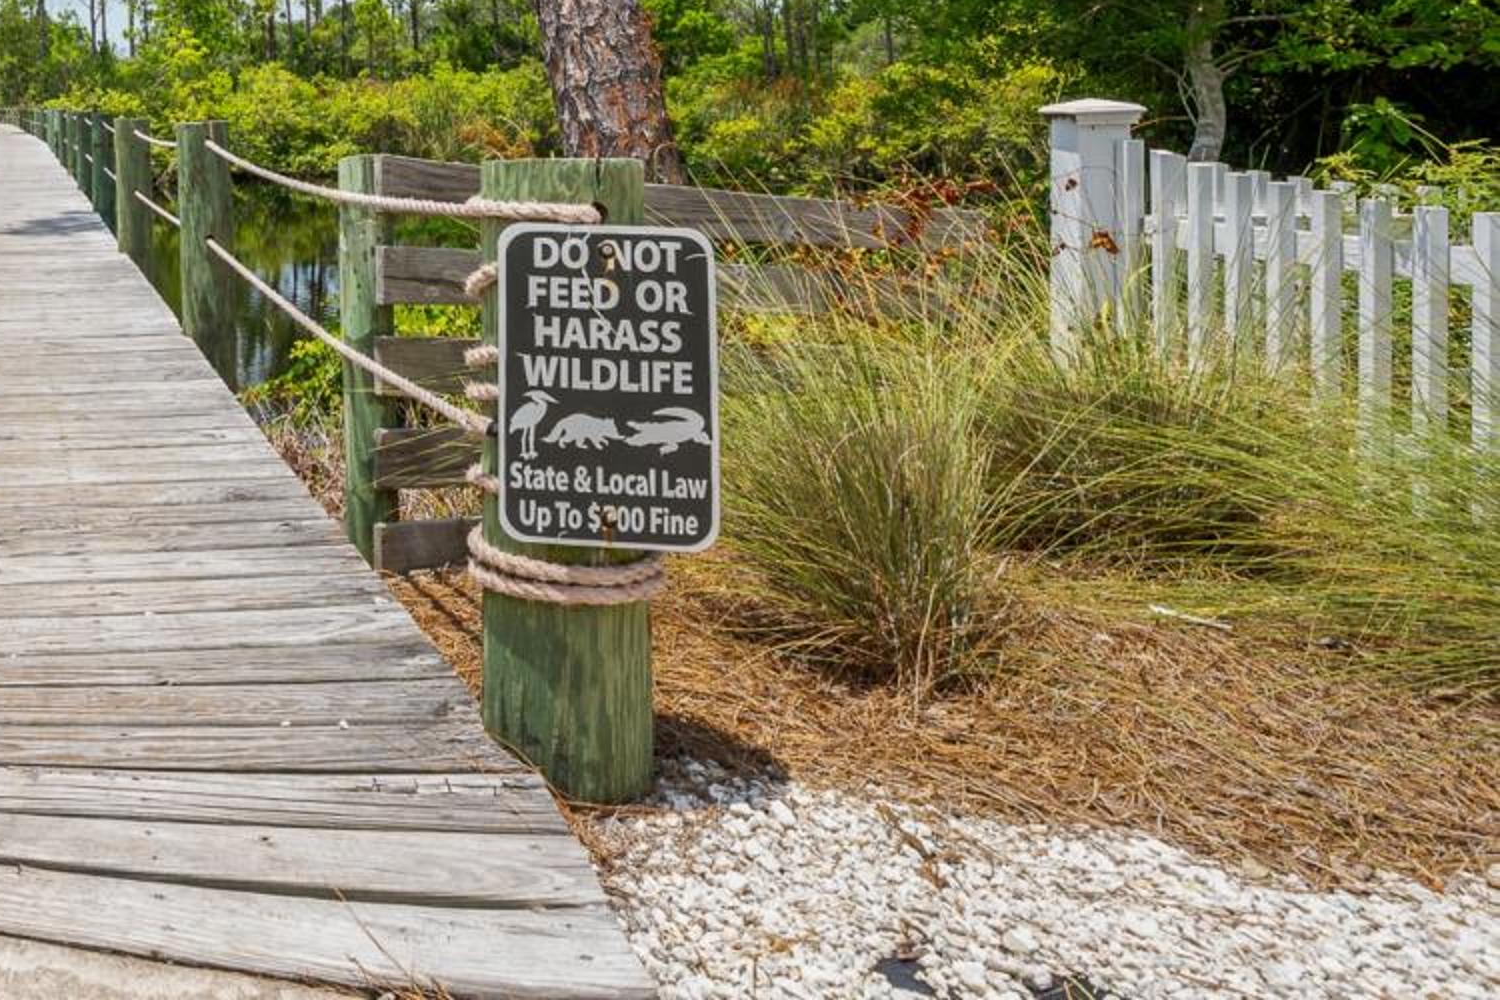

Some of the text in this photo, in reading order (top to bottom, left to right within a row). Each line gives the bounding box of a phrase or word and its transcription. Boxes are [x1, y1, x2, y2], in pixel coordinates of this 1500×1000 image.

[533, 237, 681, 275] DO NOT
[526, 276, 689, 314] FEED OR
[532, 313, 682, 352] HARASS
[520, 354, 693, 394] WILDLIFE
[509, 462, 707, 499] State & Local Law
[519, 500, 552, 532] Up
[555, 502, 582, 527] To
[650, 505, 698, 535] Fine
